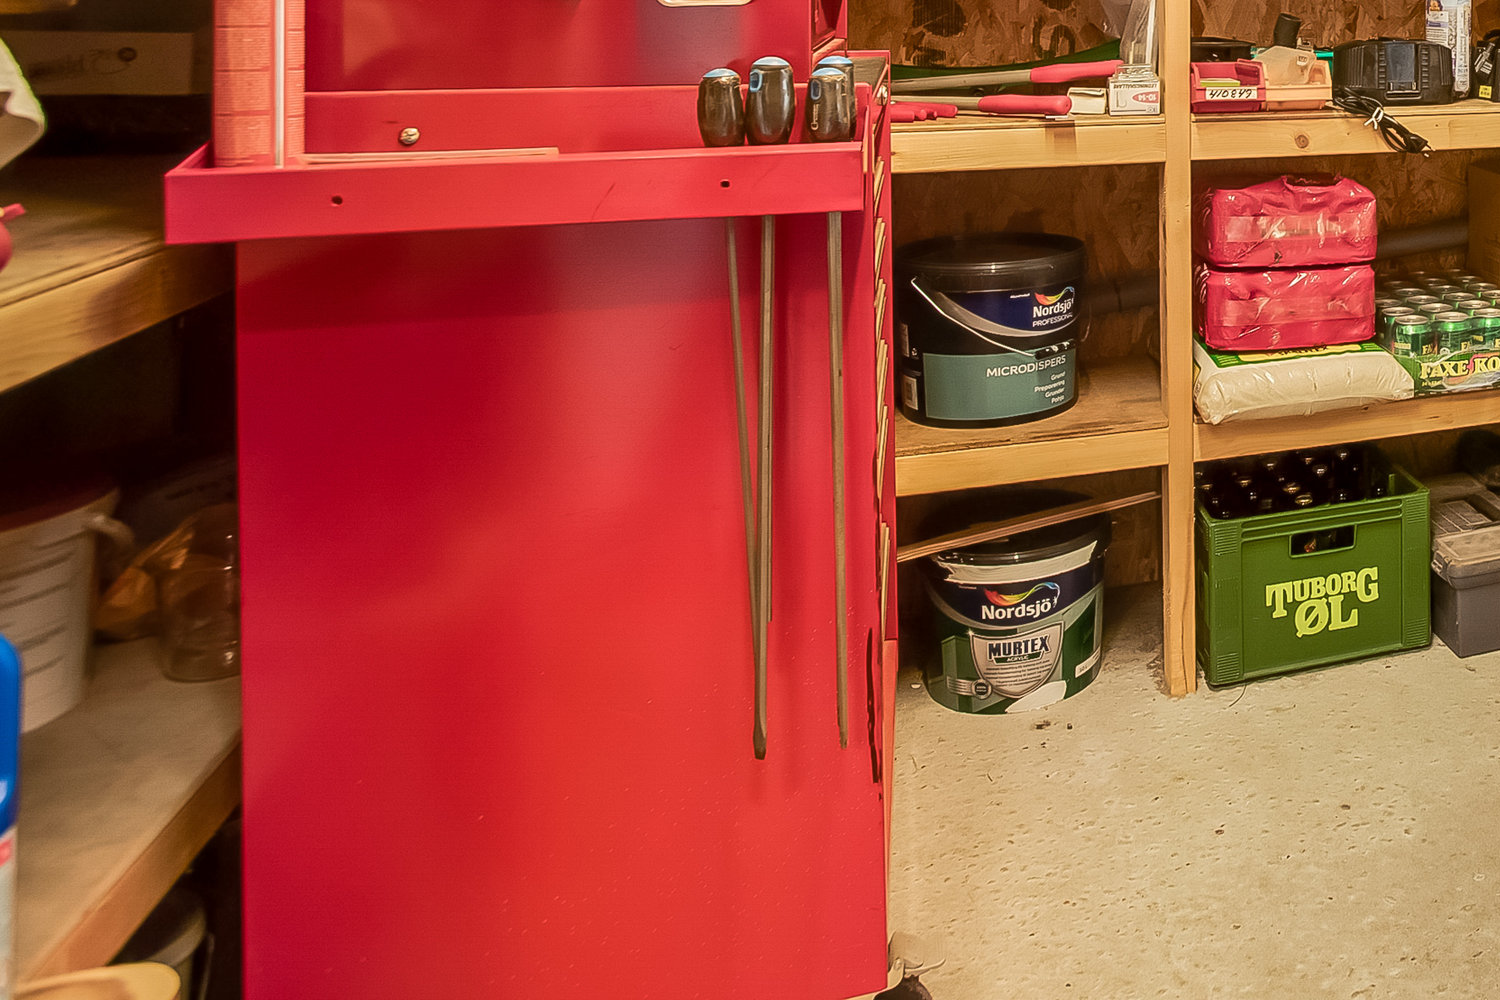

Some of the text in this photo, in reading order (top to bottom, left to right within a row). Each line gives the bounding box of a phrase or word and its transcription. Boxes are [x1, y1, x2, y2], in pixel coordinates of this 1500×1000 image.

[1033, 299, 1072, 318] Nordsjö
[986, 355, 1066, 377] MICRODISPERS
[1420, 360, 1469, 379] FAXE
[1265, 566, 1379, 619] TUBORG
[981, 598, 1052, 620] Nordsjö
[1294, 594, 1359, 638] ØL
[988, 636, 1050, 658] MURTEX
